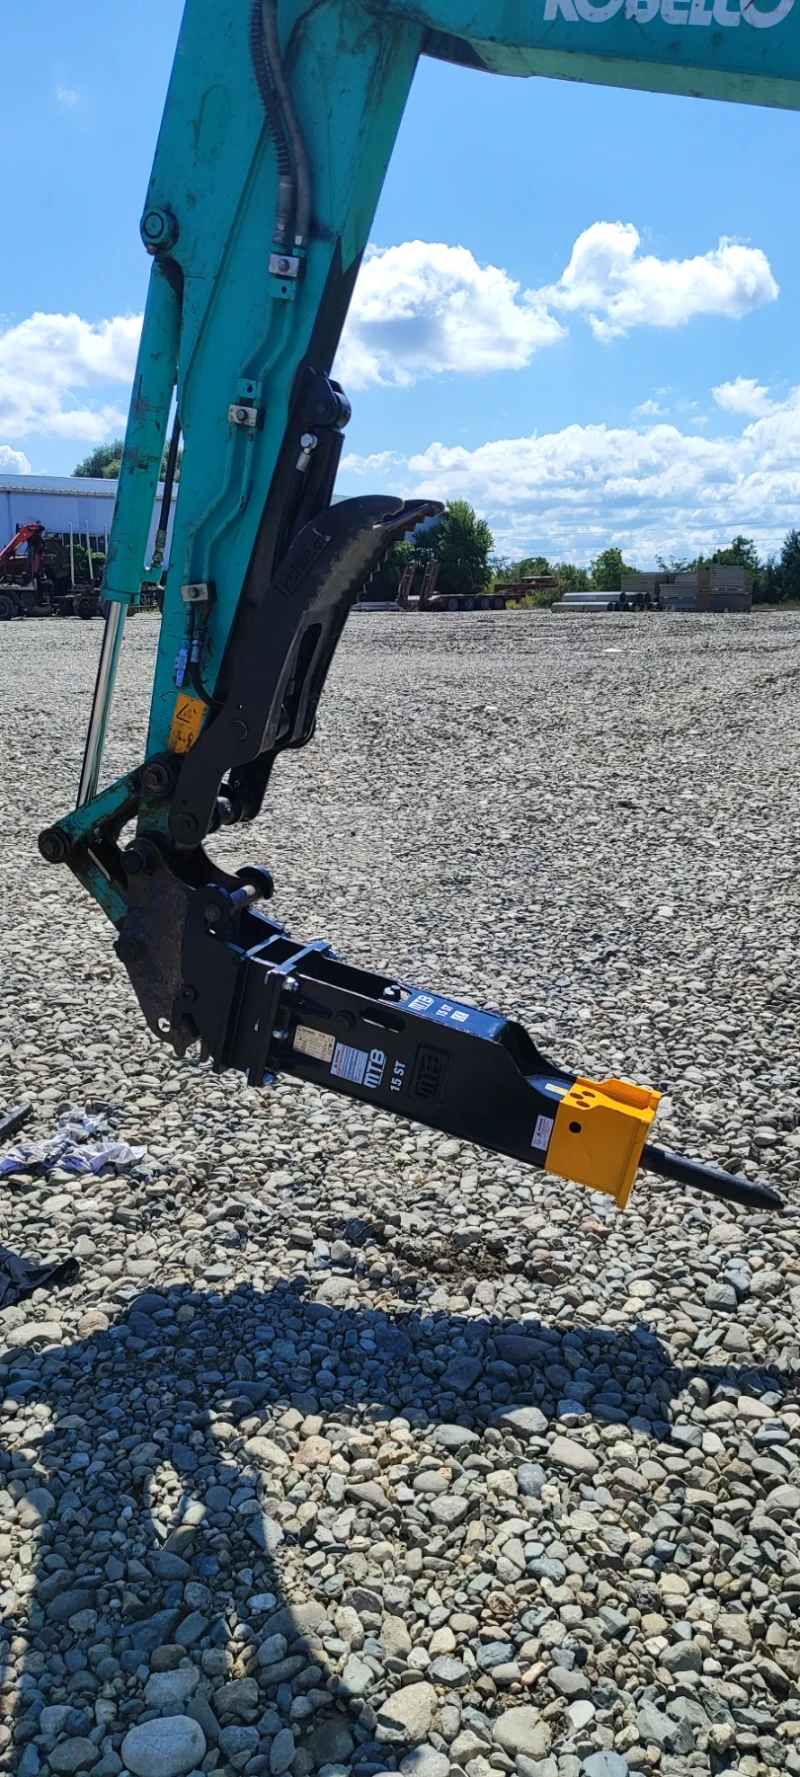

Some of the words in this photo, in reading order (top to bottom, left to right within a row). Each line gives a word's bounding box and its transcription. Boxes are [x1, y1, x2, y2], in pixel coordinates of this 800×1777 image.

[408, 994, 435, 1010] MTB
[363, 1048, 387, 1089] MTB
[394, 1060, 405, 1076] ST
[390, 1078, 402, 1092] 15
